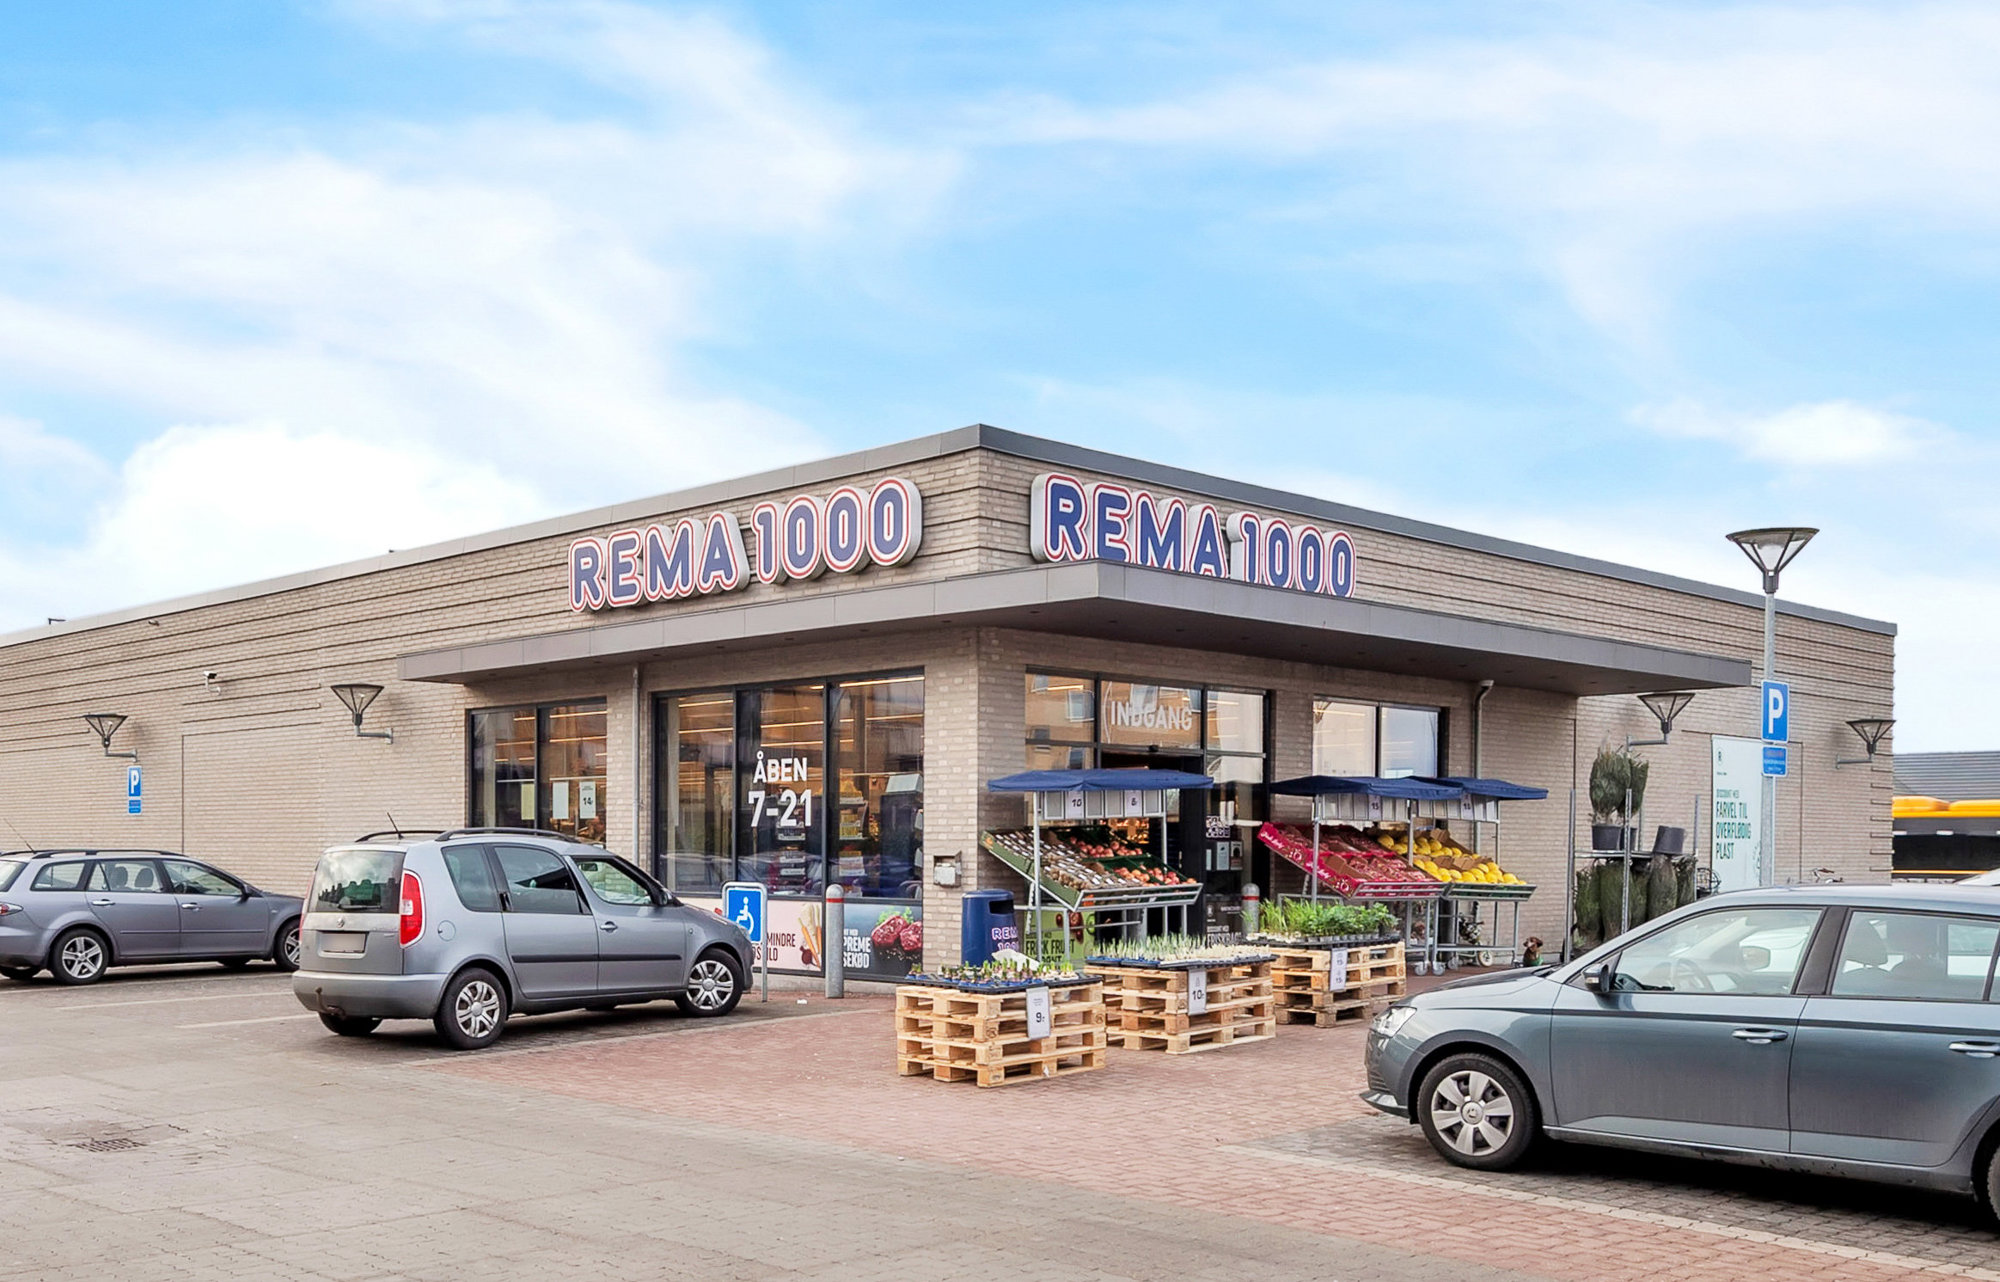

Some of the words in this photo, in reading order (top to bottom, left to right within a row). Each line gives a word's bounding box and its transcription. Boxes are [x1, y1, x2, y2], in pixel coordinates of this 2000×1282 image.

[568, 511, 740, 613] REMA
[751, 477, 911, 584] 1000
[1044, 473, 1228, 578] REMA
[1240, 512, 1358, 598] 1000
[1110, 700, 1192, 731] INDGANG
[1768, 688, 1784, 734] P
[130, 769, 140, 794] P
[752, 750, 808, 783] ÅBEN
[748, 789, 812, 827] 7-21
[1716, 842, 1735, 859] PLAST
[766, 931, 796, 947] MINDRE
